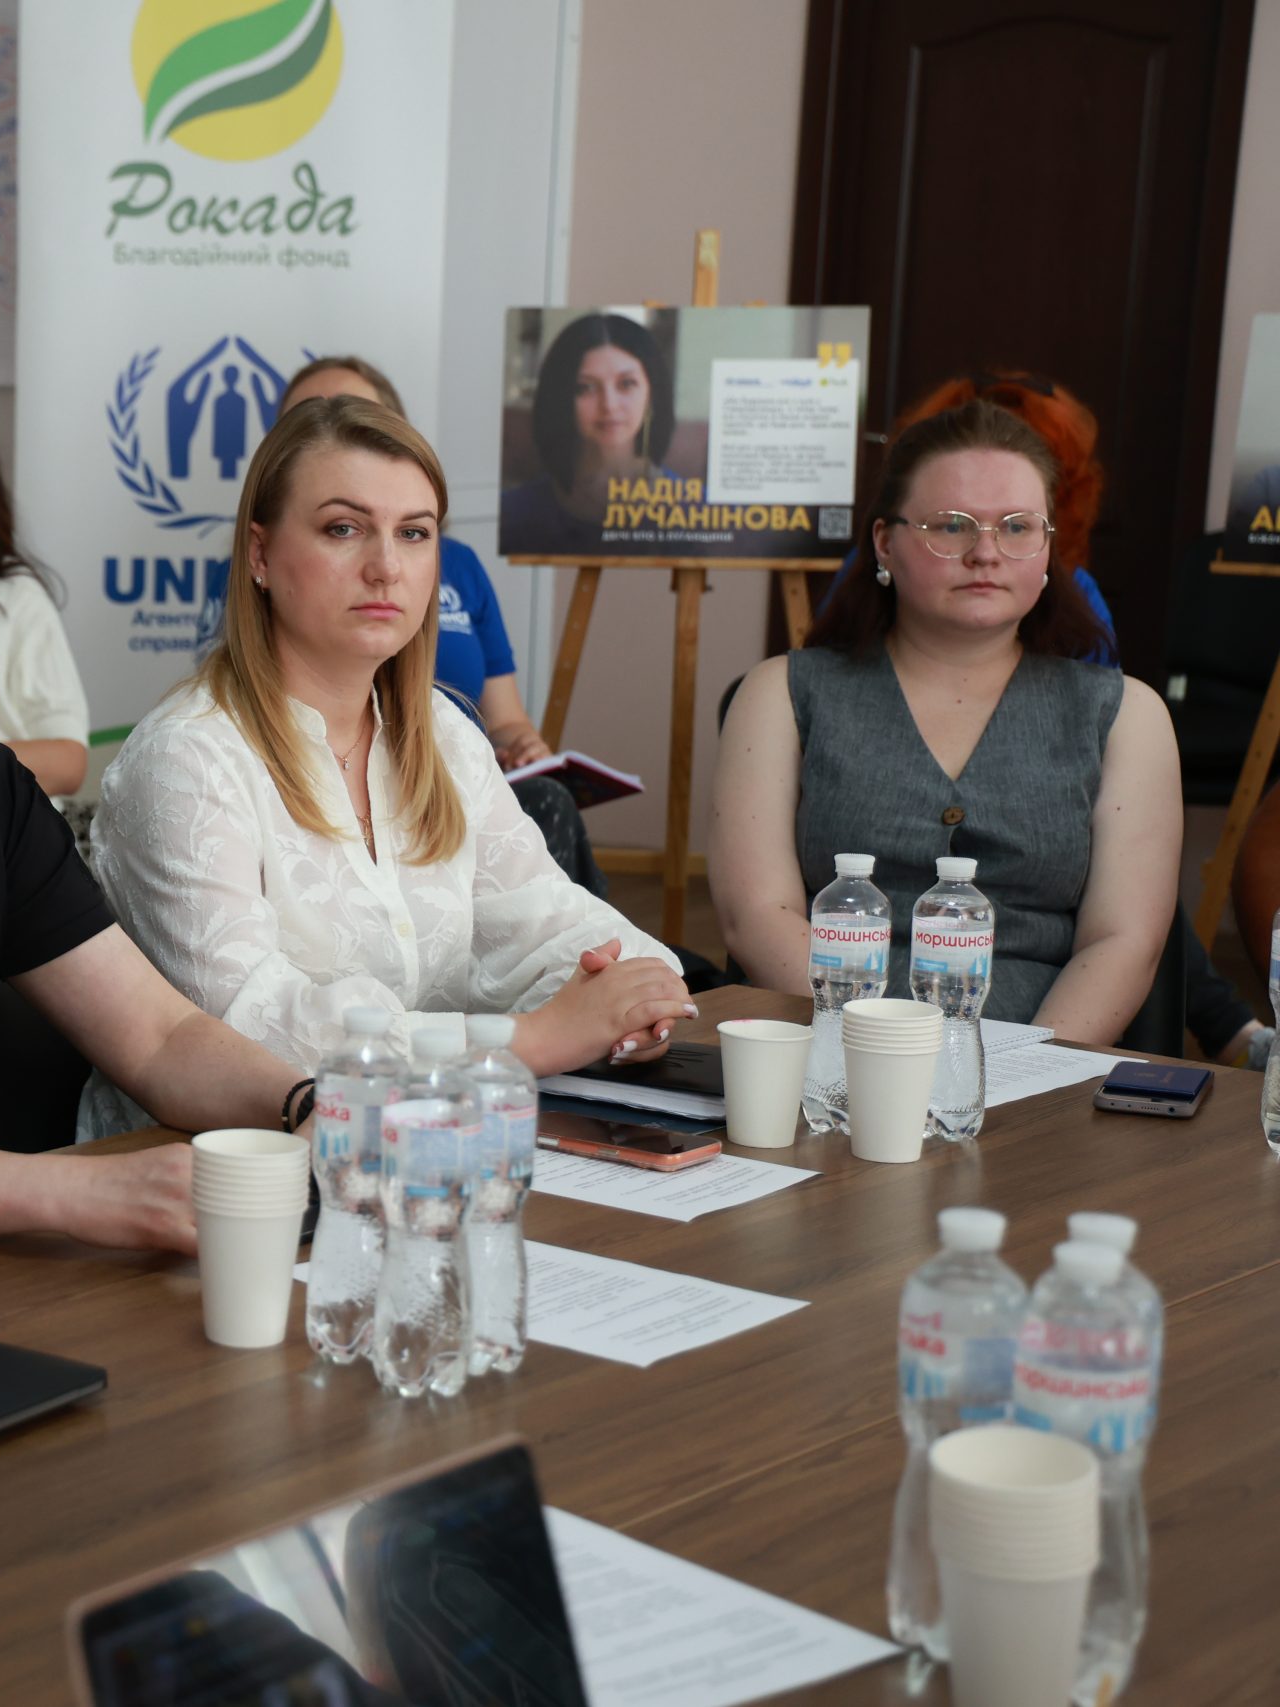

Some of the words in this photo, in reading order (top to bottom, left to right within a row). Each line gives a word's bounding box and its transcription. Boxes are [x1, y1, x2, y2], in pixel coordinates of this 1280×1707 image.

[105, 161, 360, 238] Рокада
[113, 243, 271, 268] Благодійний
[277, 247, 351, 271] фонд
[608, 478, 704, 504] НАДІЯ
[603, 503, 812, 531] ЛУЧАНІНОВА
